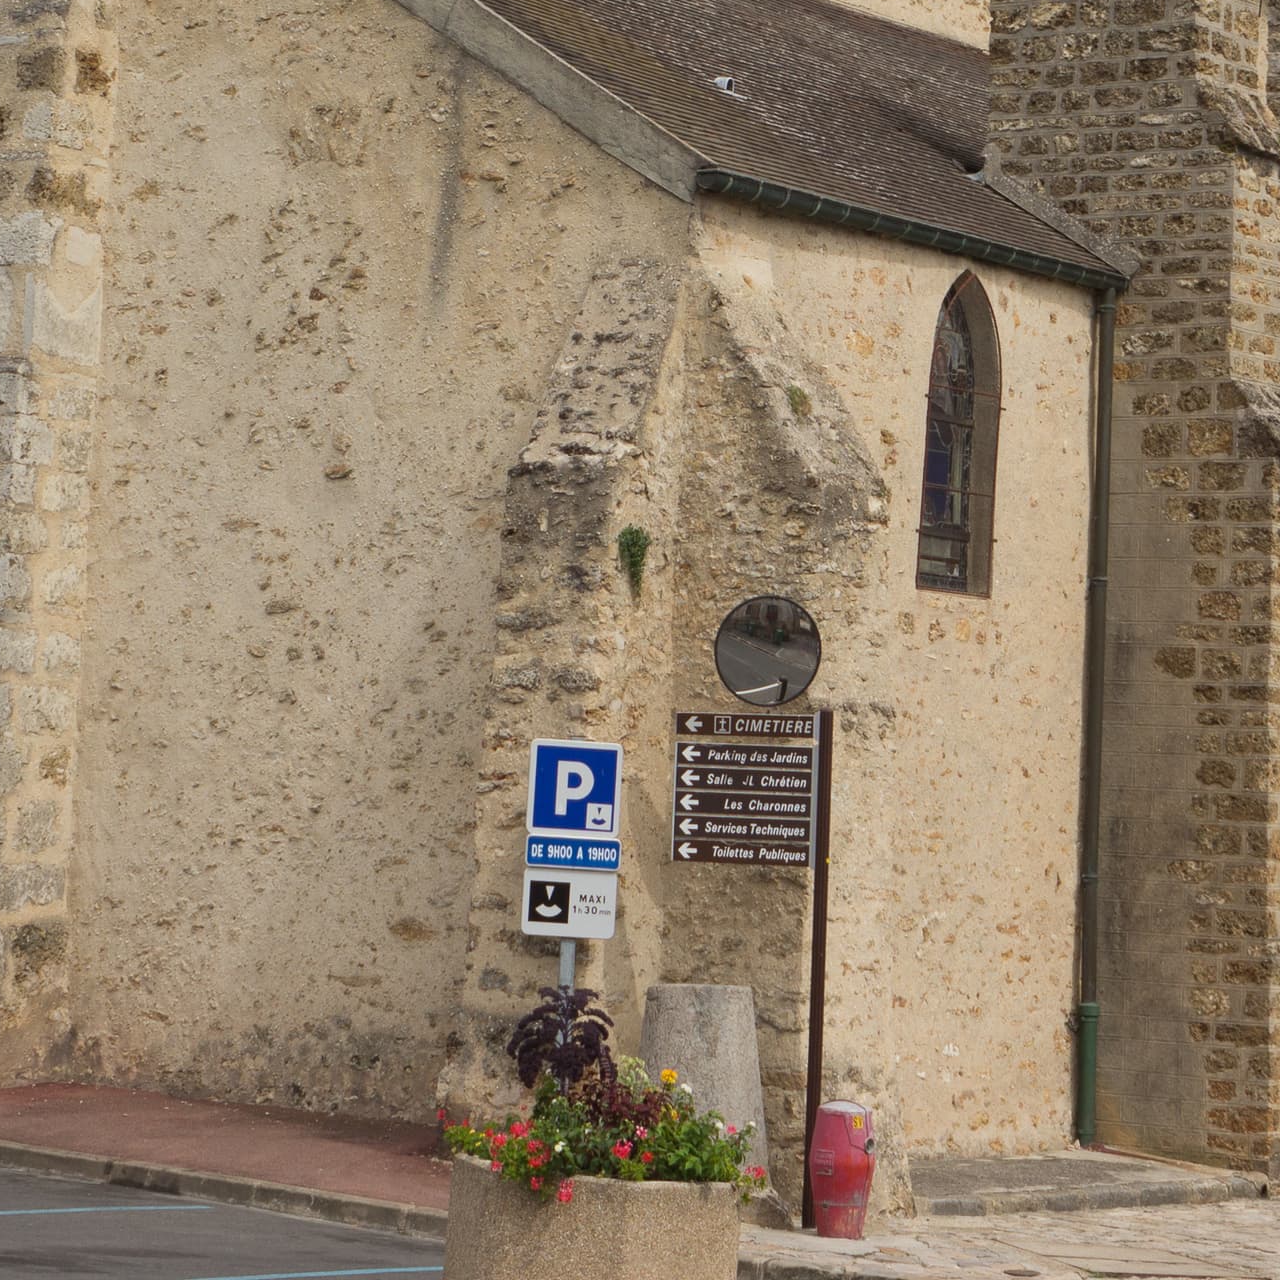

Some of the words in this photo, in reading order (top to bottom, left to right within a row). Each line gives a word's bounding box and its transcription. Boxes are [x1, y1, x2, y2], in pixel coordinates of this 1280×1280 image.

[735, 718, 812, 734] CIMETIERE
[708, 749, 747, 764] Parking
[750, 751, 767, 762] des
[770, 752, 808, 764] Jardins
[554, 760, 595, 816] P
[707, 773, 733, 785] Salle
[742, 775, 754, 786] JL
[760, 775, 807, 788] Chrétien
[724, 798, 743, 810] Les
[748, 799, 807, 813] Charonnes
[705, 821, 747, 834] Services
[750, 823, 805, 839] Techniques
[531, 843, 544, 857] DE
[547, 844, 573, 859] 9H00
[576, 845, 584, 860] A
[587, 847, 617, 862] 19H00
[712, 845, 754, 858] Toilettes
[759, 847, 807, 863] Publiques
[579, 894, 606, 904] MAXI
